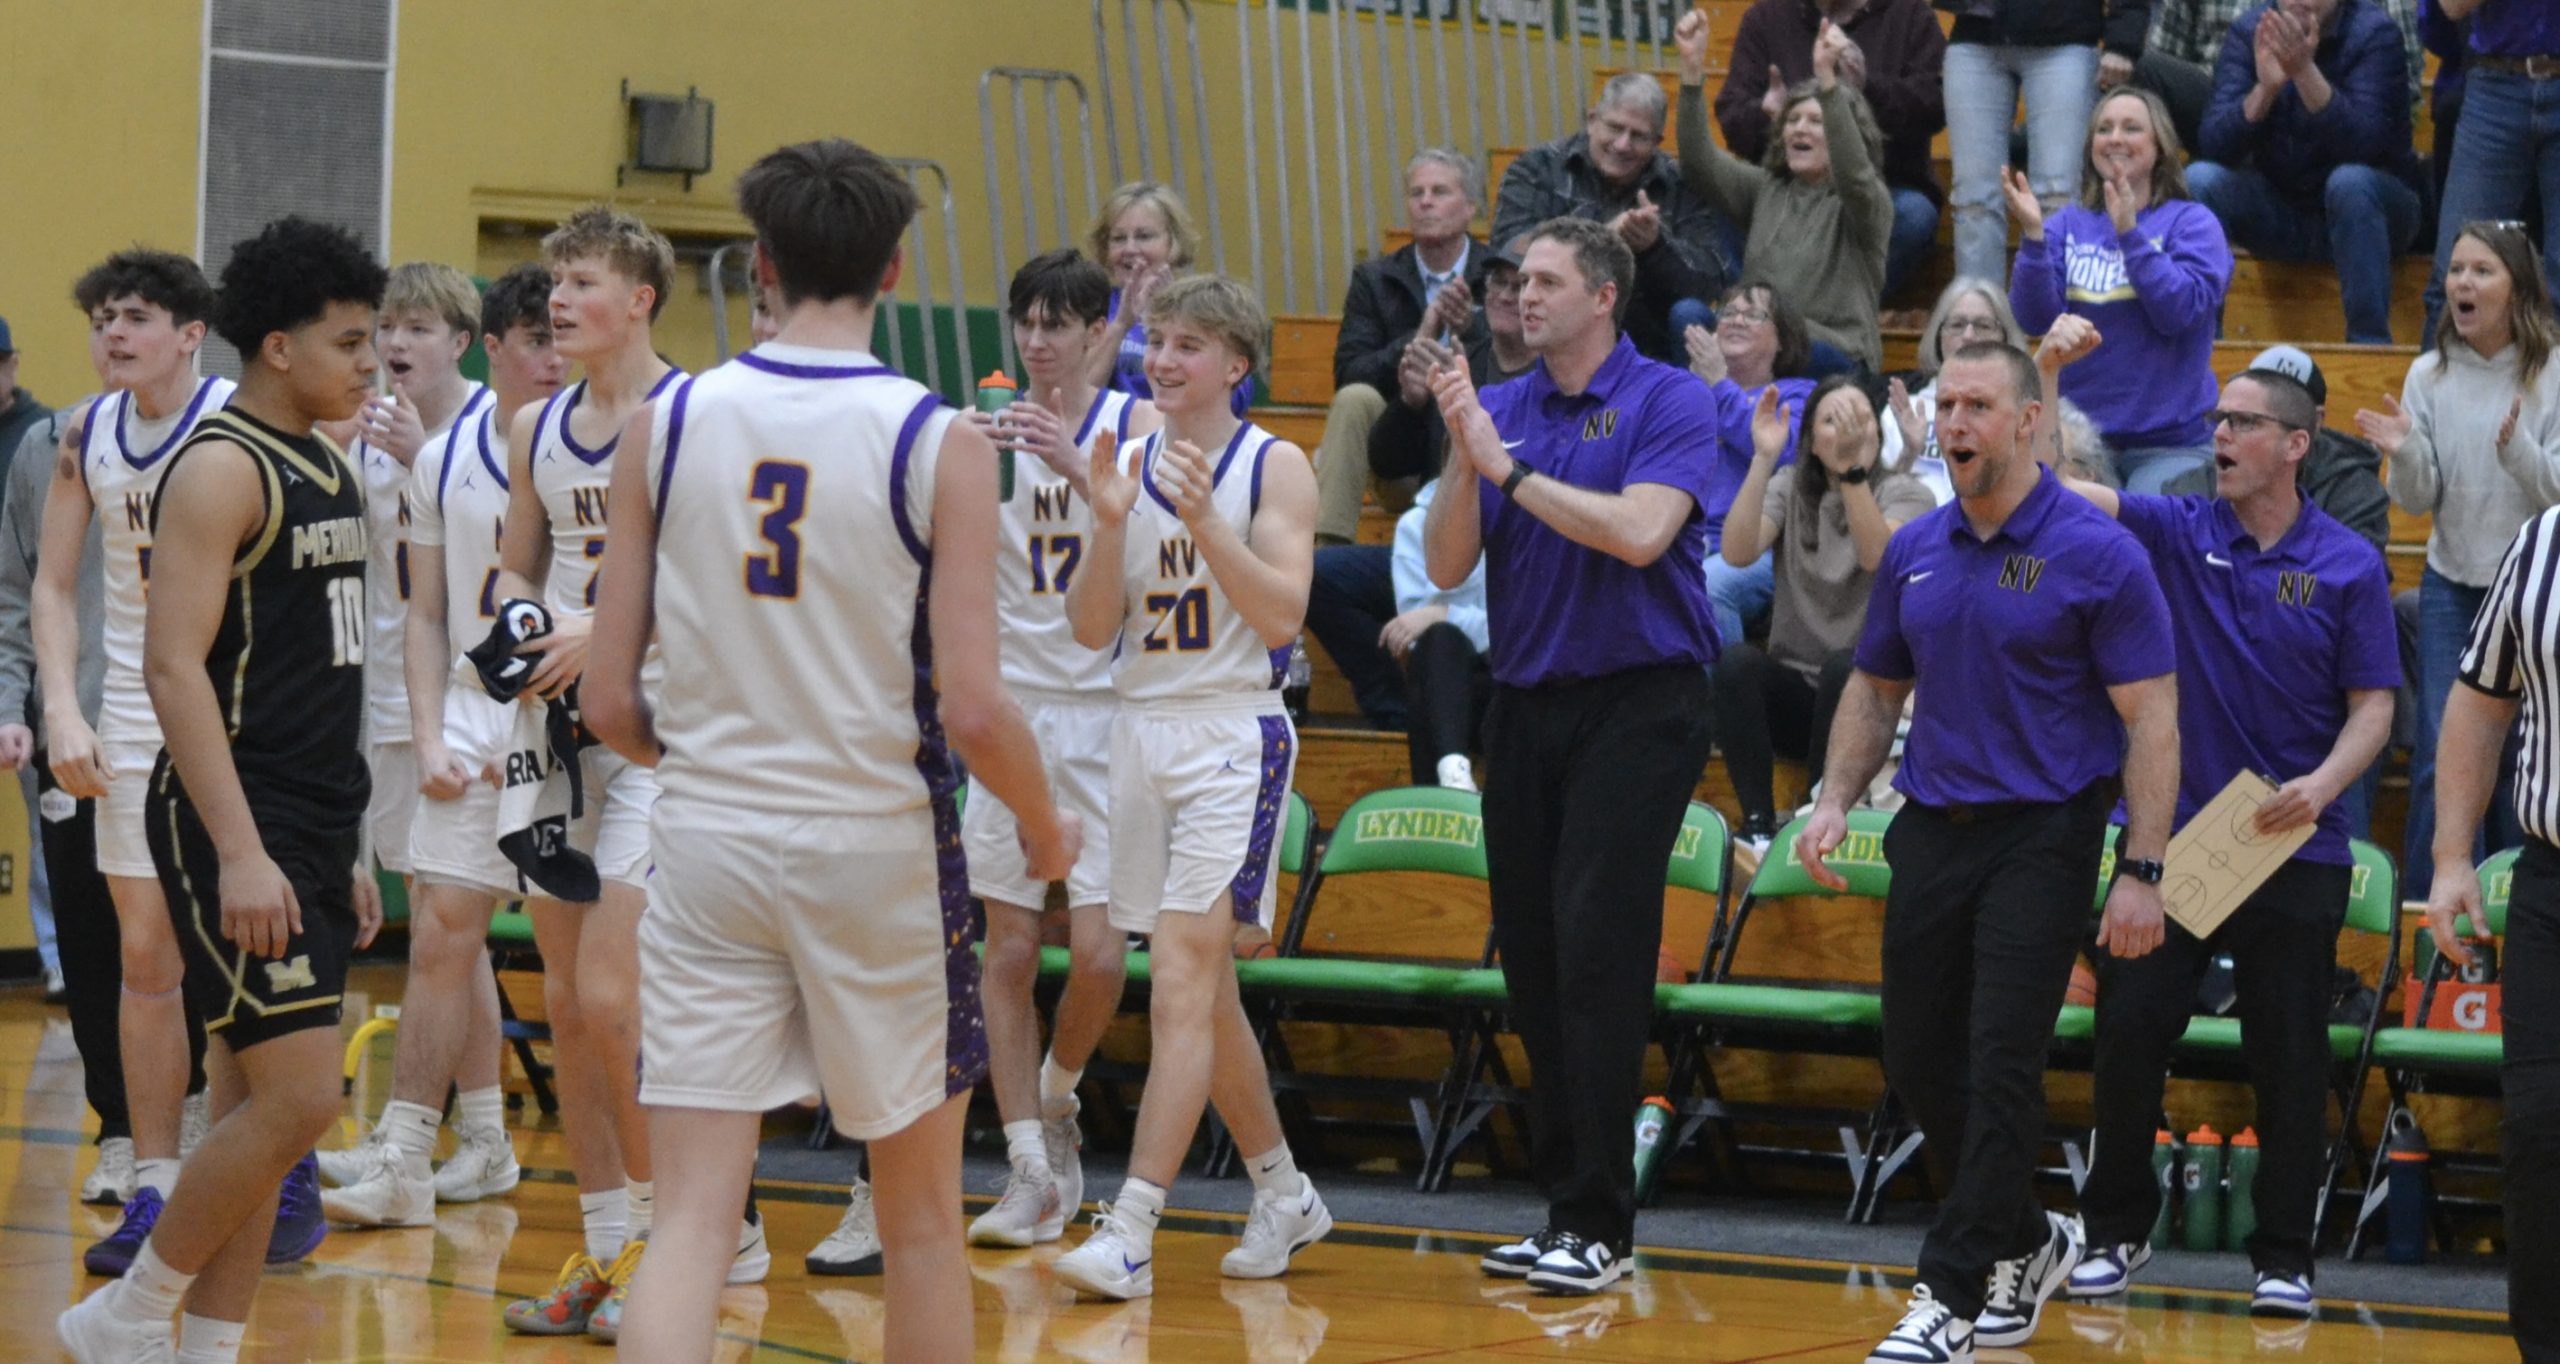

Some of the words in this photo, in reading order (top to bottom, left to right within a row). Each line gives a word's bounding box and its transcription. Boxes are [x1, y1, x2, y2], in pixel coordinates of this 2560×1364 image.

[1583, 408, 1620, 441] NV
[1033, 483, 1072, 521] NV
[742, 456, 814, 603] 3
[1029, 530, 1083, 596] 12
[1159, 538, 1196, 579] NV
[1999, 554, 2046, 593] NV
[2276, 570, 2317, 608] NV
[326, 576, 365, 667] 10
[1144, 584, 1212, 653] 20
[1357, 809, 1482, 848] LYNDEN
[2453, 992, 2488, 1030] G
